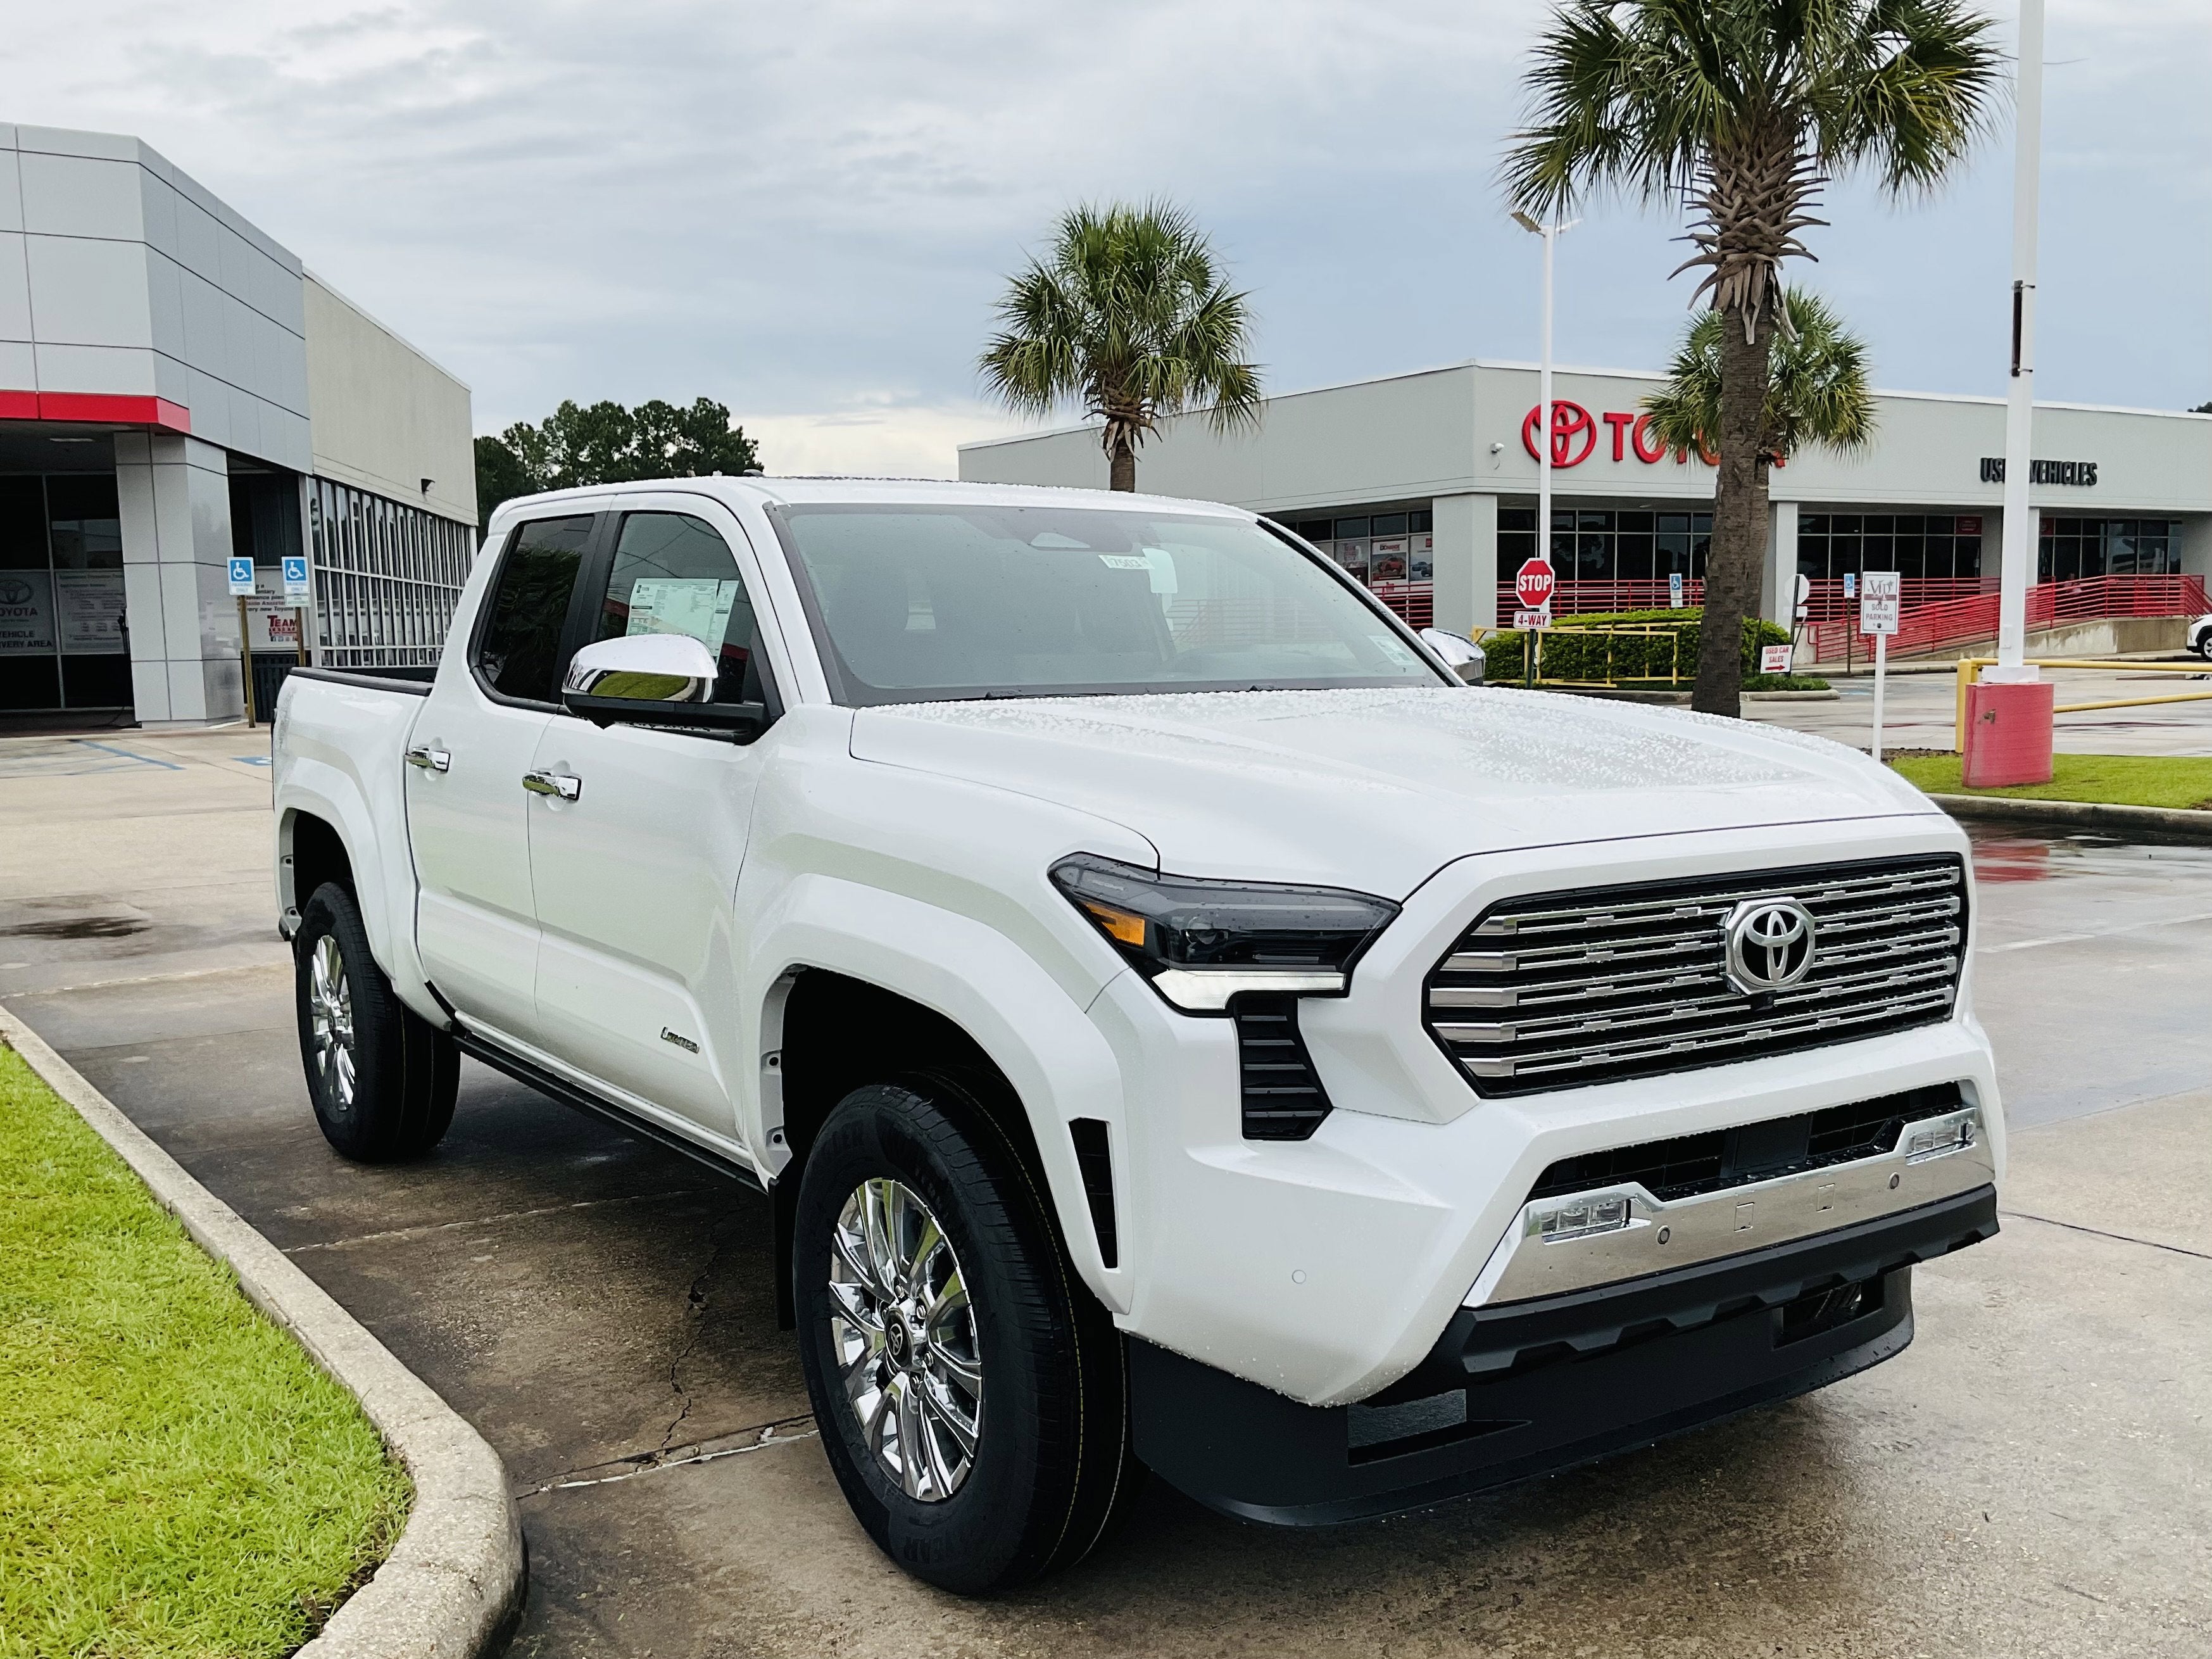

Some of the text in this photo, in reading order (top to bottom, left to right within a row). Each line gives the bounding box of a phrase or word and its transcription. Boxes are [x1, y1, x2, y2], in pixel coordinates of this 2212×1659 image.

[1981, 458, 2097, 486] US VEHICLES
[1519, 574, 1552, 592] STOP
[0, 607, 38, 617] OYOTA
[1866, 613, 1893, 621] PARKING
[1518, 614, 1547, 626] 4-WAY
[1765, 647, 1778, 655] USED
